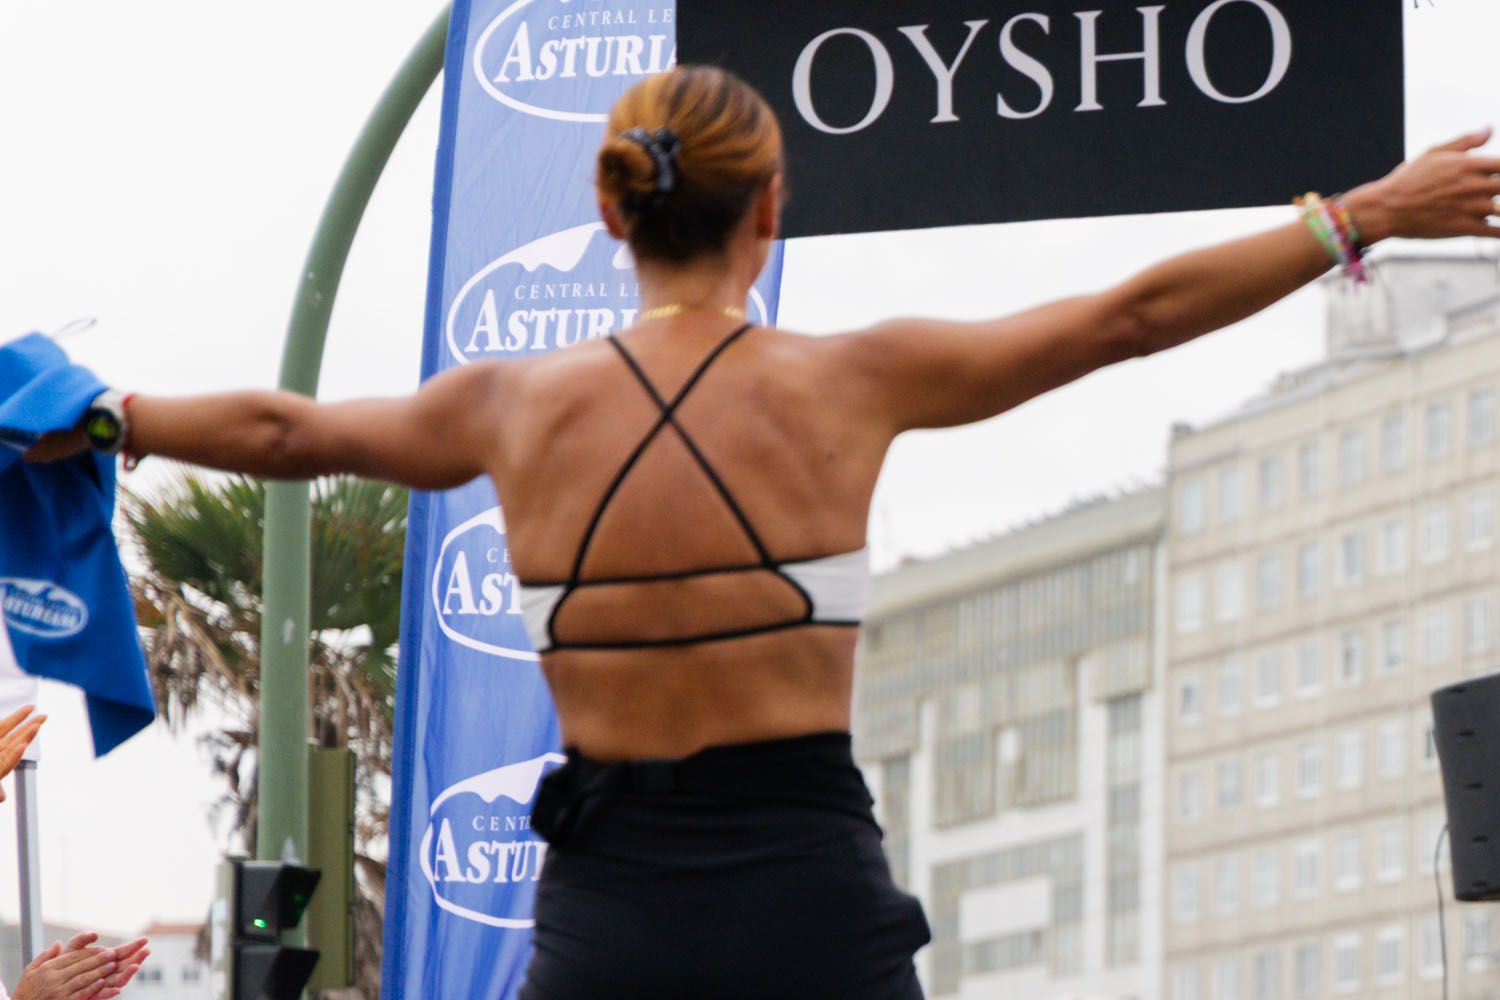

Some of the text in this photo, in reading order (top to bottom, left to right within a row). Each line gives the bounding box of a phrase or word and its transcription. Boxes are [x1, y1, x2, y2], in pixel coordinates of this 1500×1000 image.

[547, 10, 637, 30] CENTRAL
[792, 0, 1291, 134] OYSHO
[515, 283, 609, 300] CENTRAL
